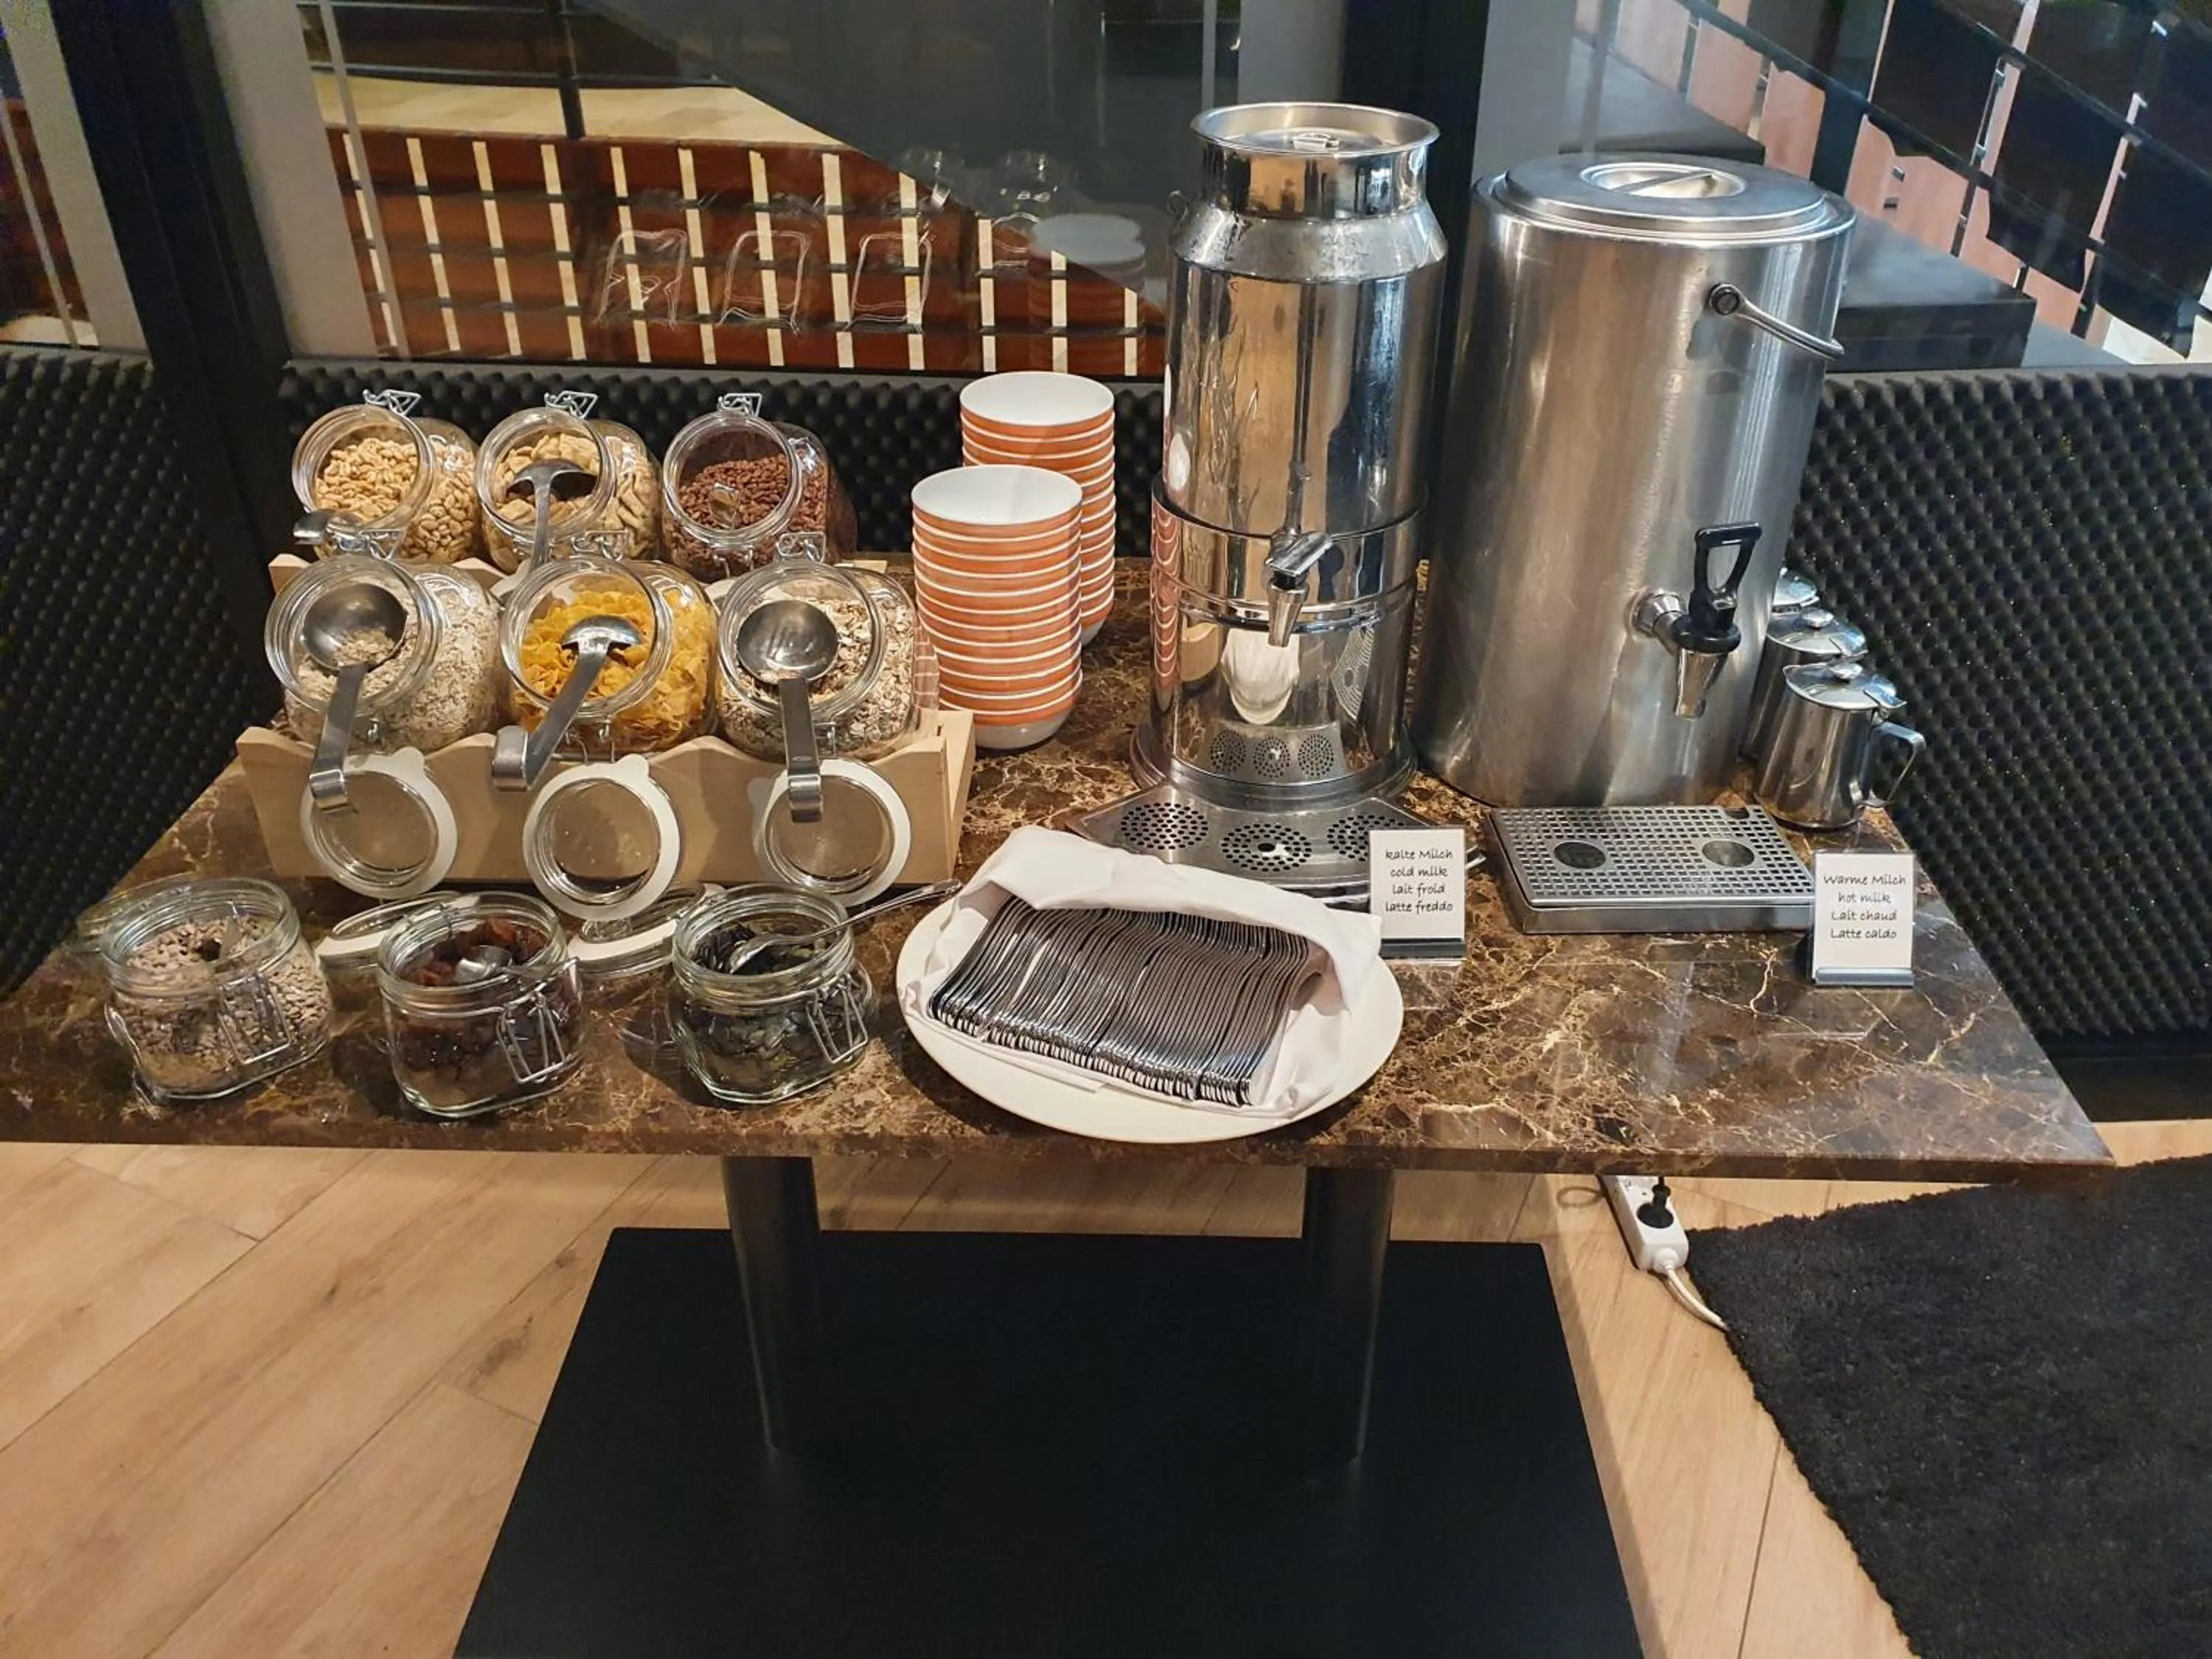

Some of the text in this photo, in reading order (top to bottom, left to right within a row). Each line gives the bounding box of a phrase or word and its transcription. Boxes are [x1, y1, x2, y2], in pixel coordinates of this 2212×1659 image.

[1385, 849, 1453, 859] kalte Milch
[1390, 866, 1448, 877] cold milk
[1871, 874, 1906, 885] Milch
[1416, 883, 1446, 897] froid
[1838, 892, 1892, 903] hot milk
[1415, 900, 1453, 915] freddo
[1860, 910, 1897, 921] chaud
[1830, 928, 1897, 939] Latte caldo
